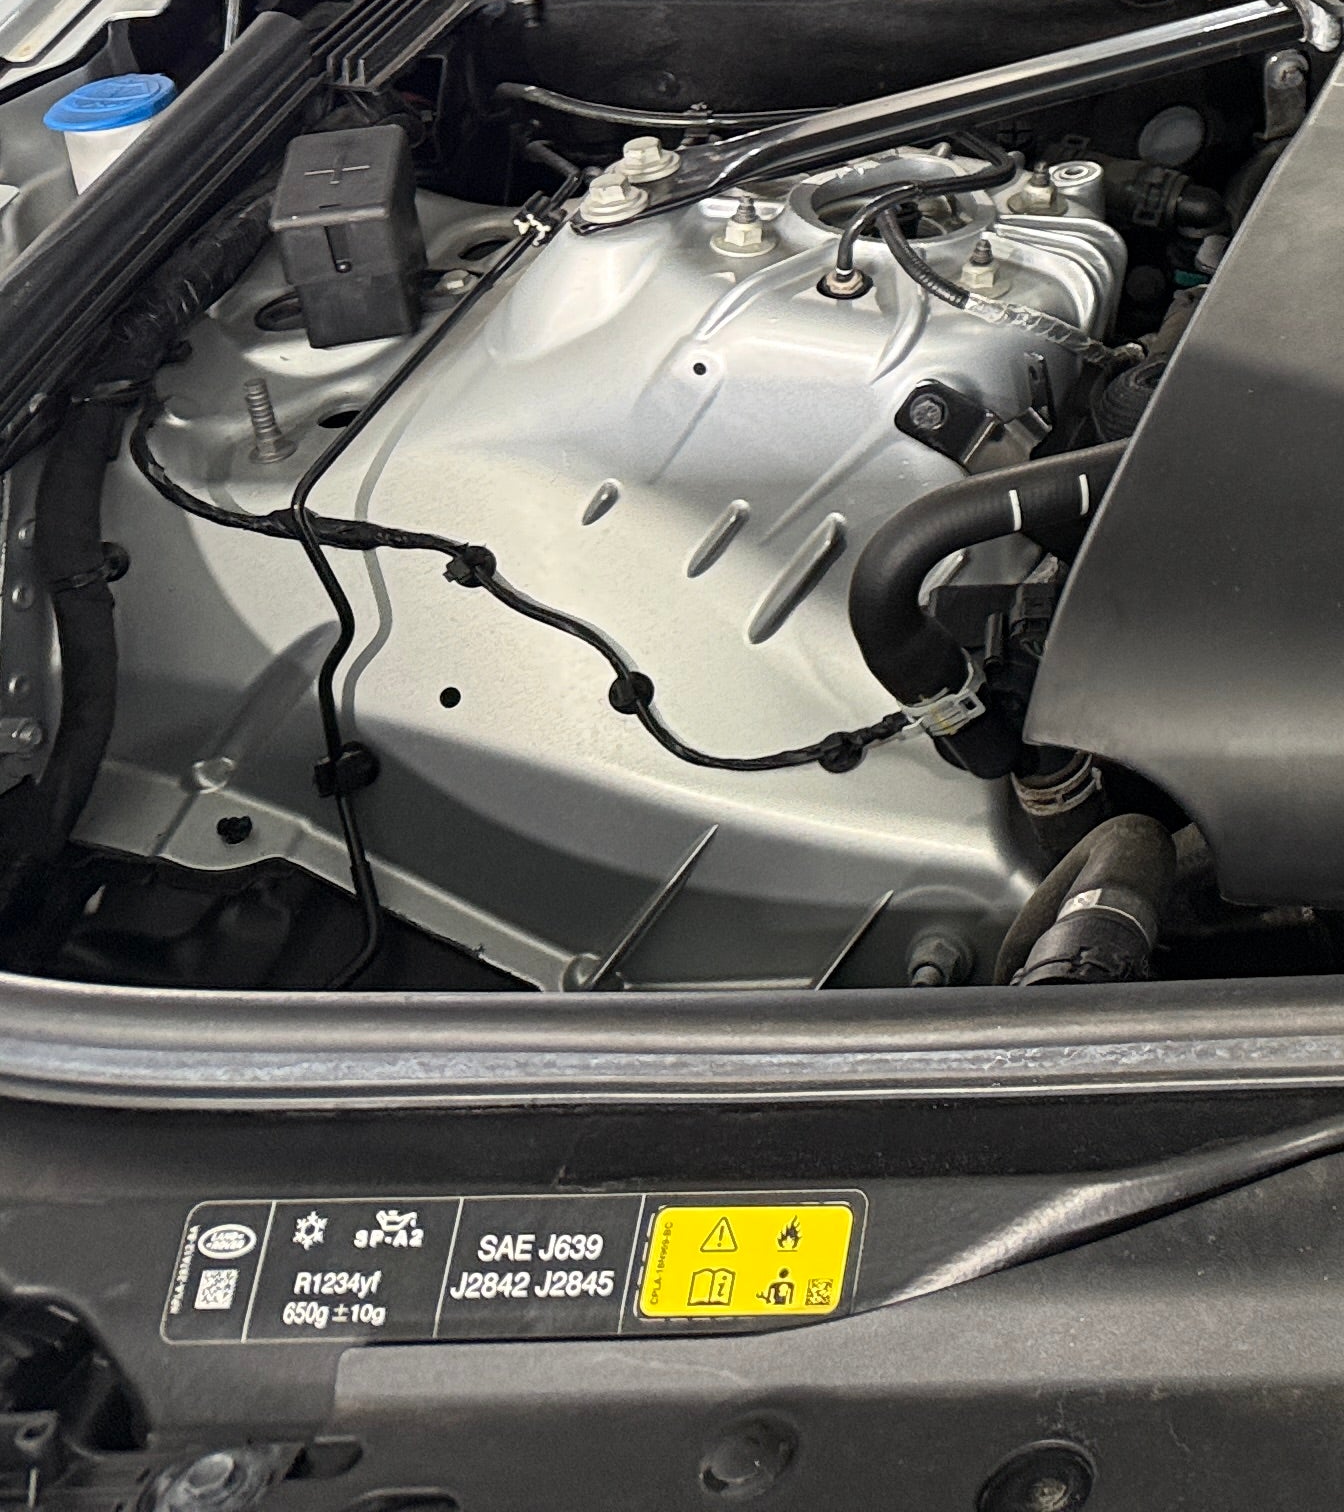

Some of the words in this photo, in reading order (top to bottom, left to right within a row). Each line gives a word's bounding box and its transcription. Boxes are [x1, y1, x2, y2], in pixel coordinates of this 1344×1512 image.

[477, 1234, 536, 1262] SAE
[538, 1233, 604, 1262] J639
[293, 1270, 382, 1299] R1234yf
[450, 1271, 531, 1300] J2842
[534, 1270, 615, 1299] J2845
[282, 1301, 329, 1329] 650g
